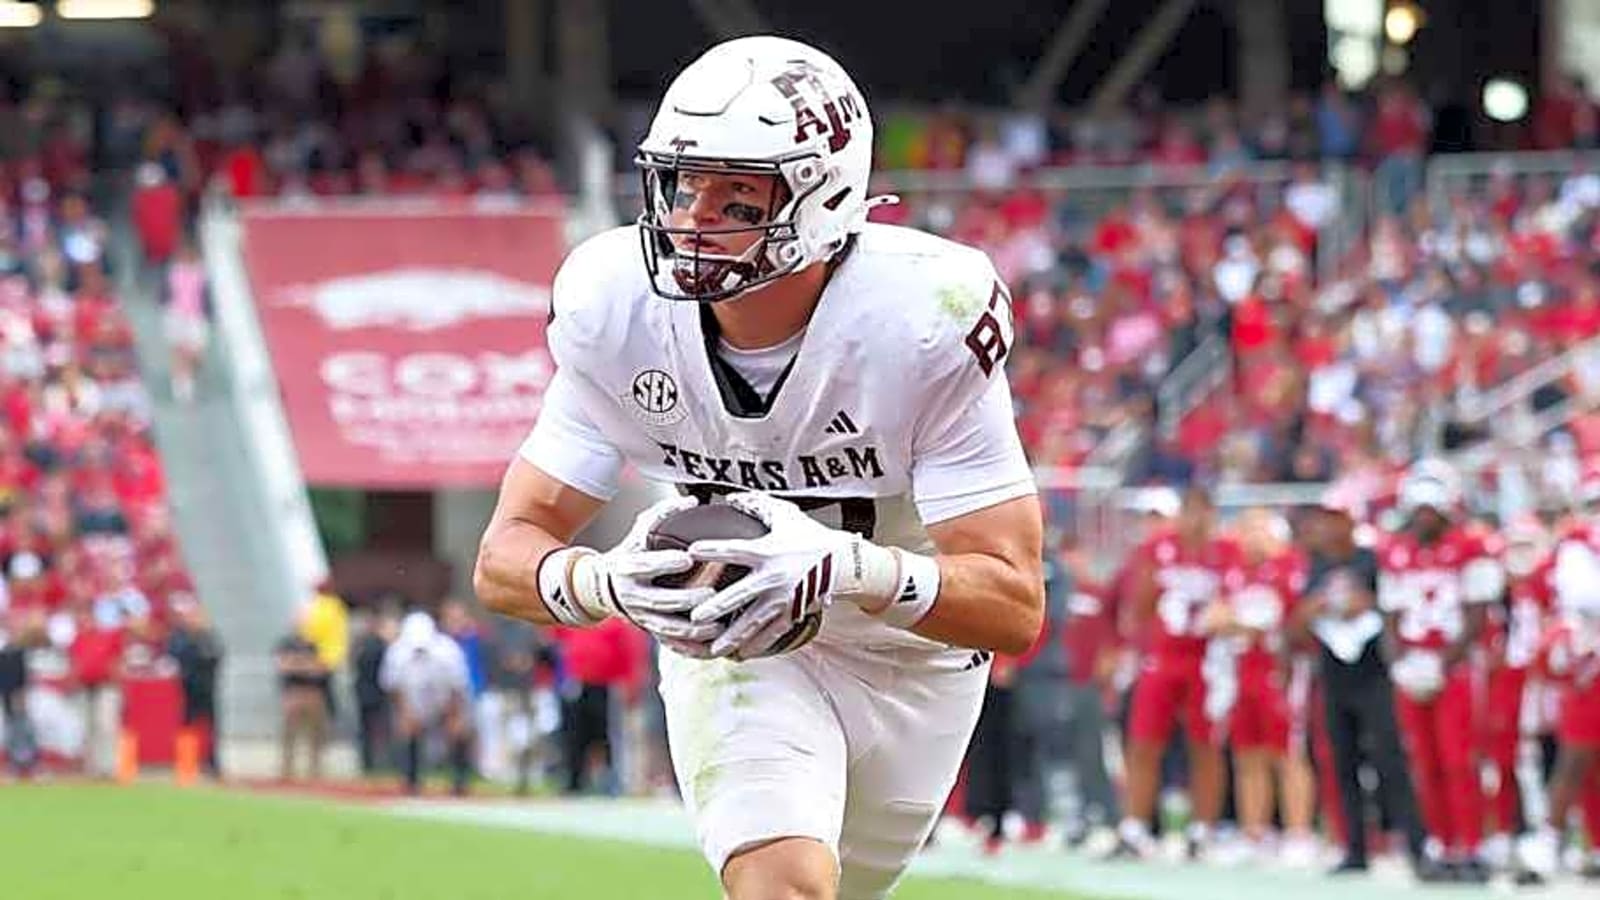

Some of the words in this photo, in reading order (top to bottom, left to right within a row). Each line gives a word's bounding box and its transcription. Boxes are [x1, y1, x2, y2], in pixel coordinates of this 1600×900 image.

[634, 371, 677, 413] SEC
[658, 441, 788, 491] TEXAS
[798, 446, 884, 487] A&M
